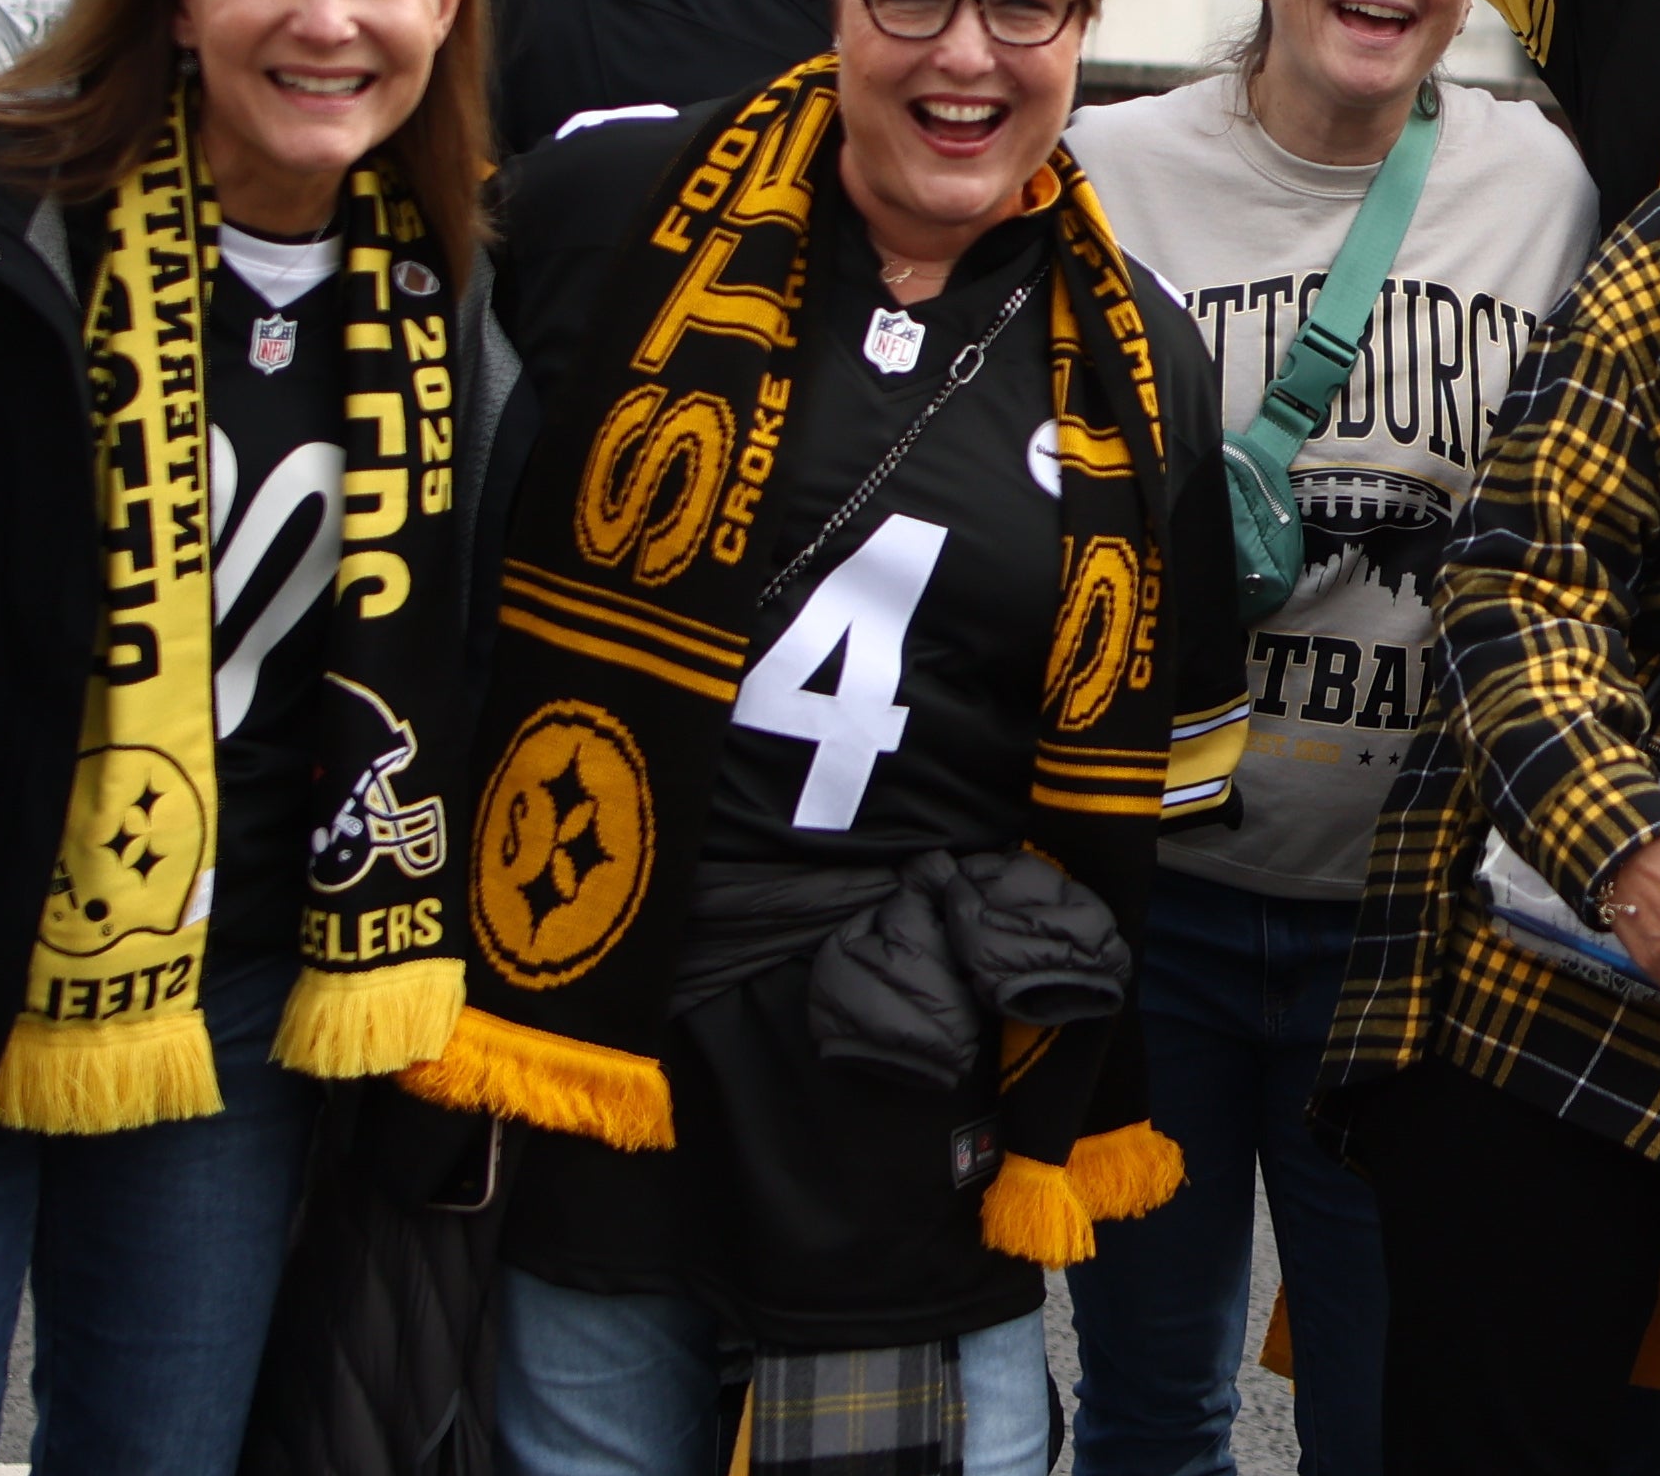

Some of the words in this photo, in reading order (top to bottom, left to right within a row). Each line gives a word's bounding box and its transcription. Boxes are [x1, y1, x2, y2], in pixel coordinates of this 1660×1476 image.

[258, 337, 292, 363] NFL
[402, 315, 453, 515] 2025
[876, 330, 910, 363] NFL
[711, 372, 792, 566] CROKE
[731, 512, 949, 831] 4
